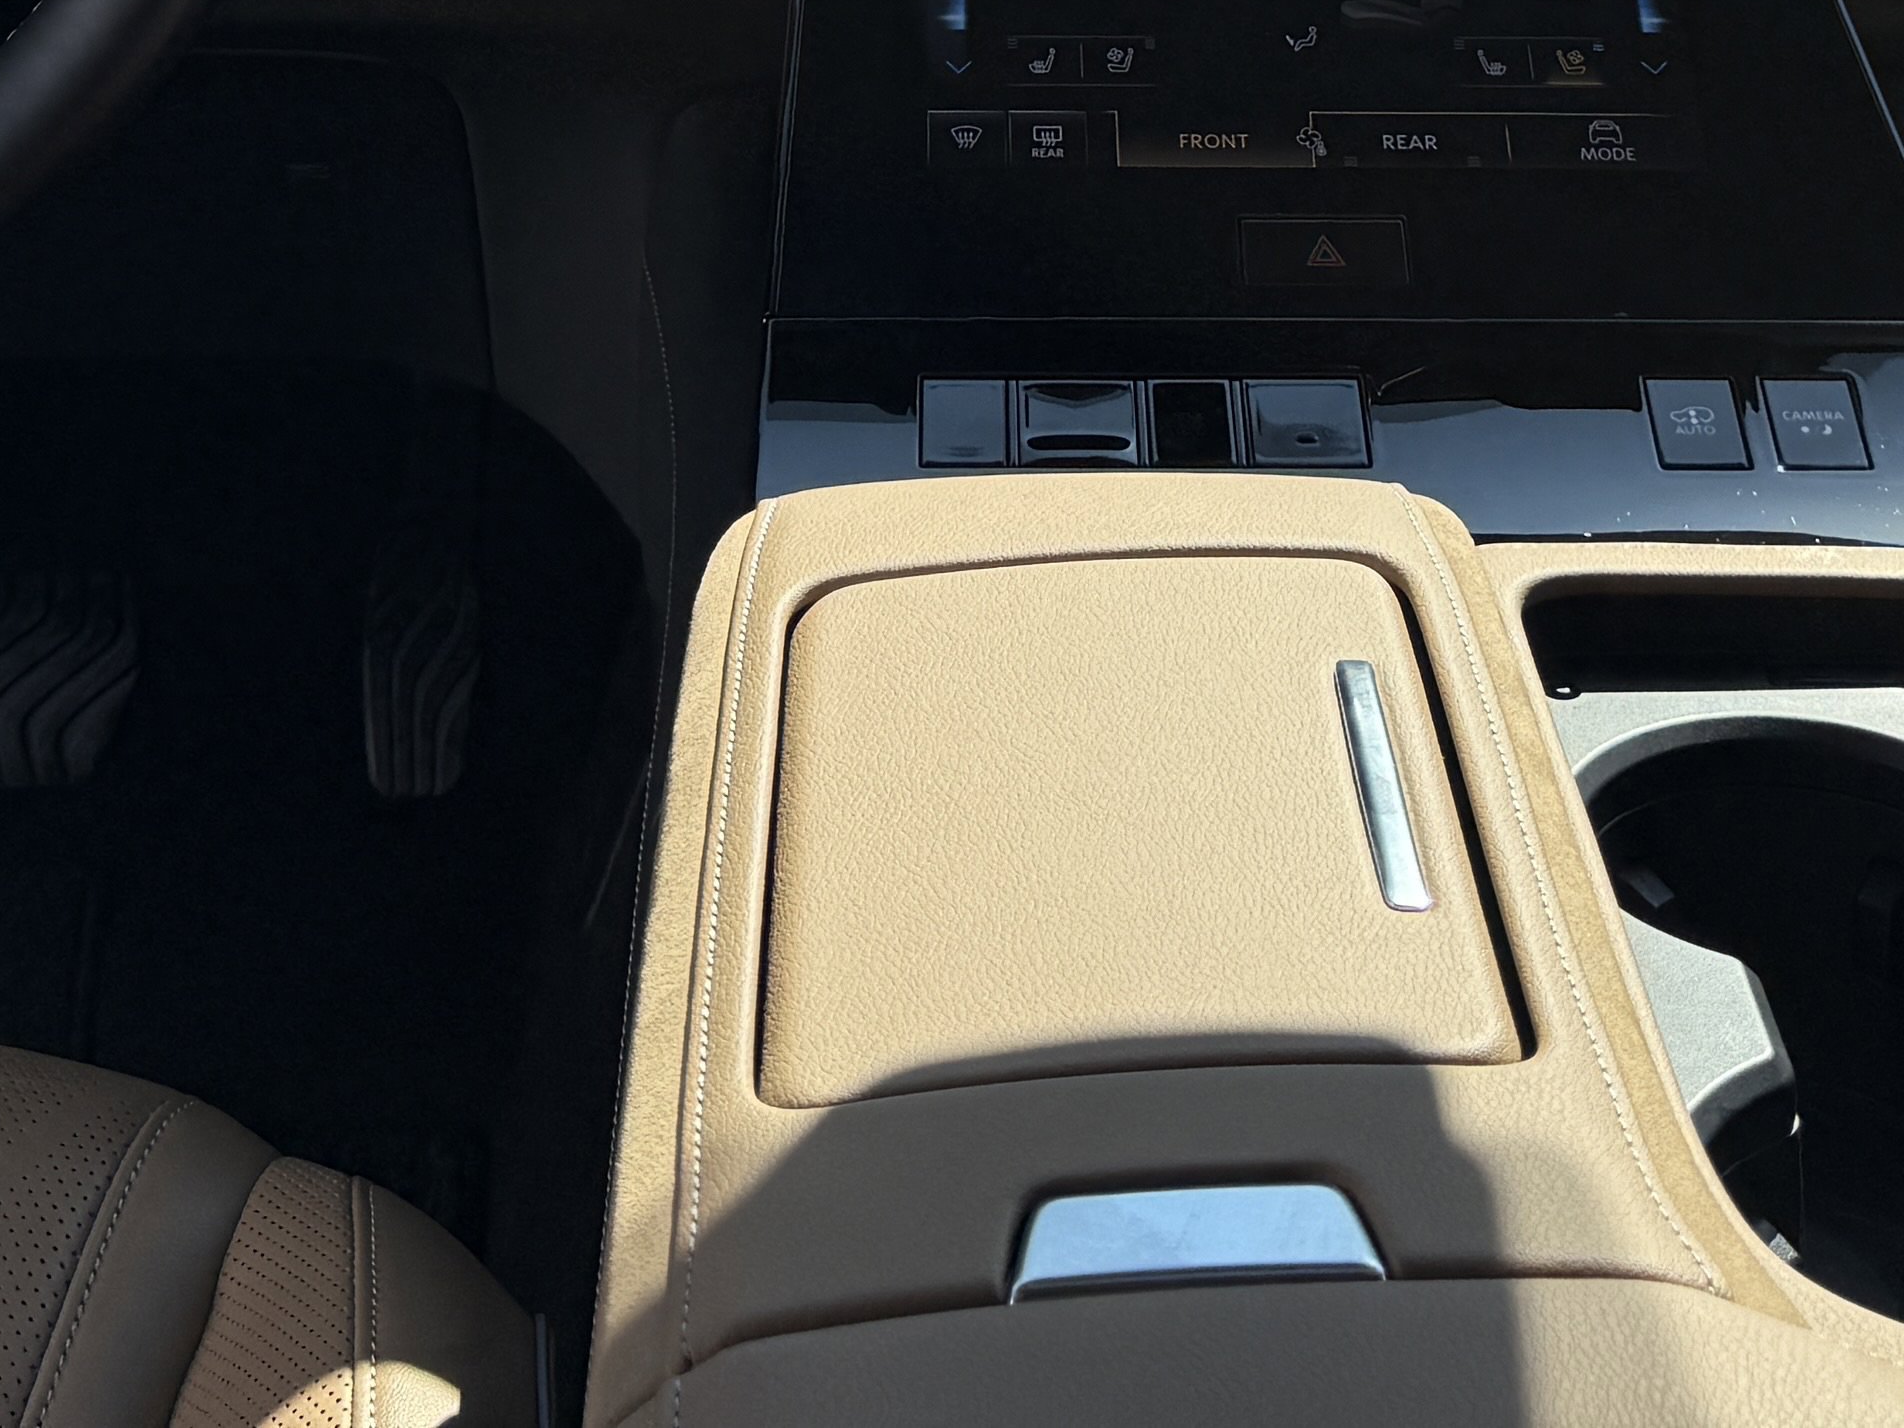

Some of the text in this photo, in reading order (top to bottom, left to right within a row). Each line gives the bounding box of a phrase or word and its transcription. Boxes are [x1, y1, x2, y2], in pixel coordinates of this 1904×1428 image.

[1179, 132, 1249, 150] FRONT
[1382, 134, 1439, 152] REAR
[1031, 147, 1065, 159] REAR
[1580, 146, 1637, 163] MODE
[1781, 409, 1845, 422] CAMERA
[1674, 424, 1717, 436] AUTO
